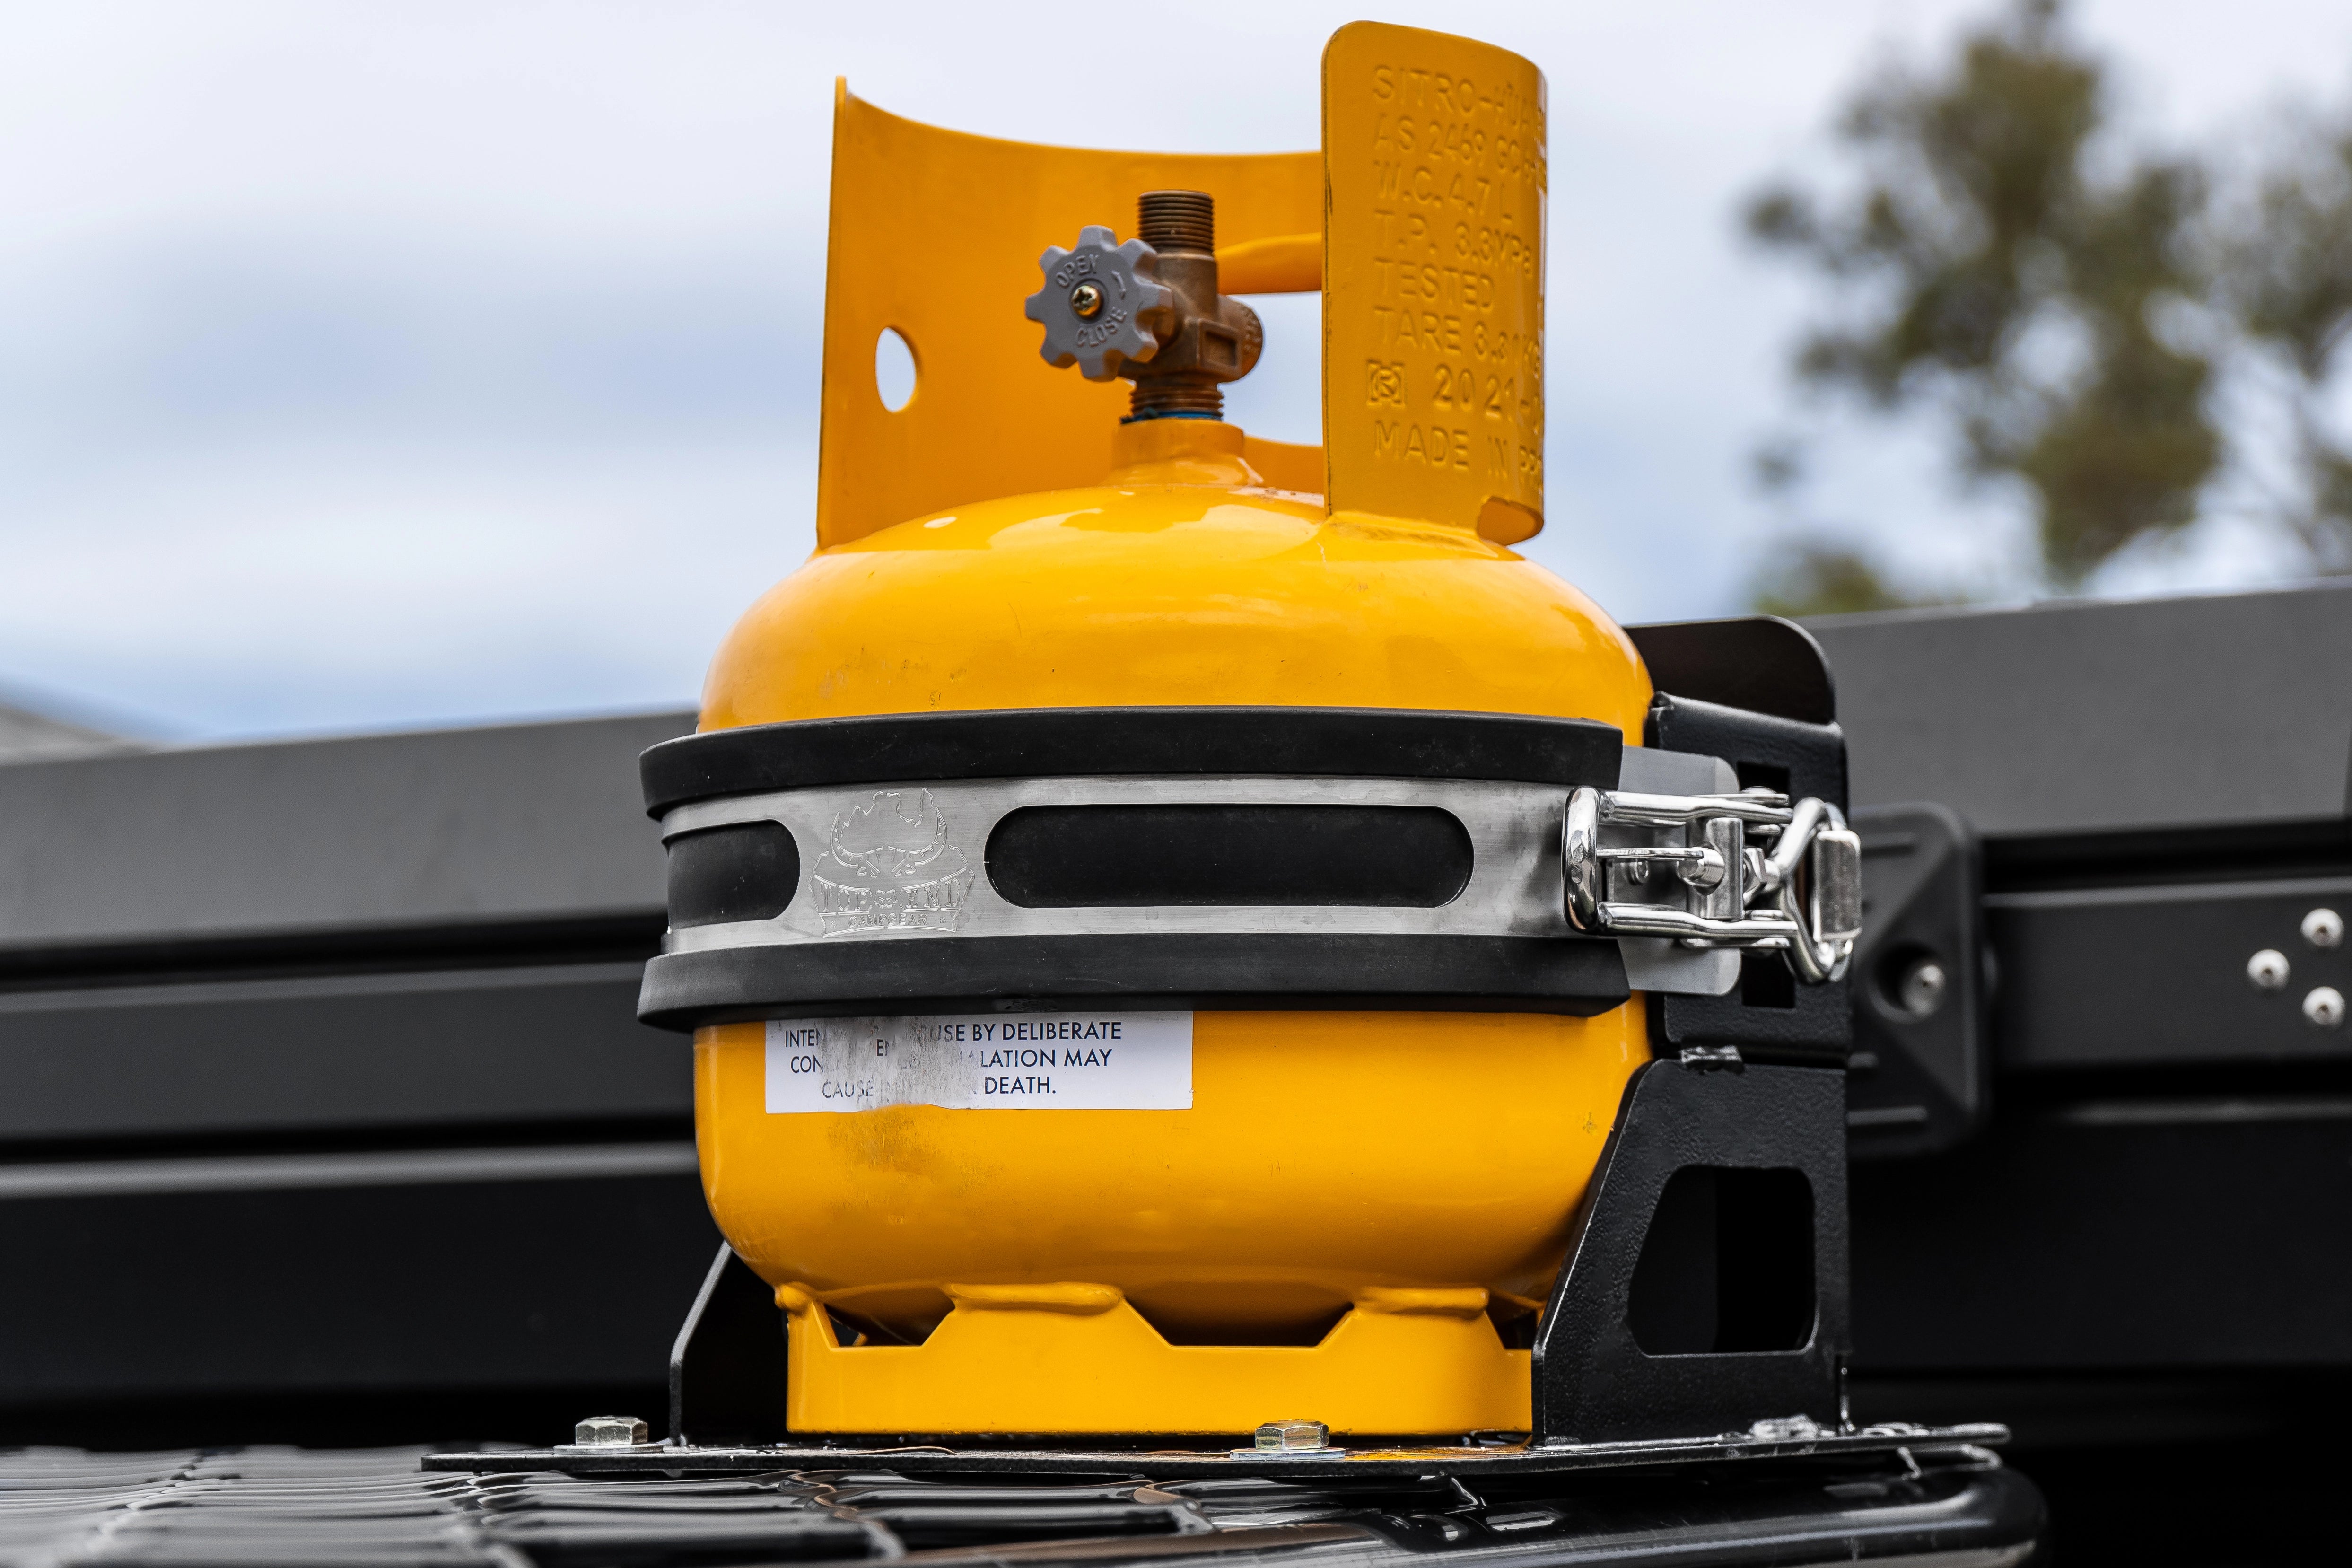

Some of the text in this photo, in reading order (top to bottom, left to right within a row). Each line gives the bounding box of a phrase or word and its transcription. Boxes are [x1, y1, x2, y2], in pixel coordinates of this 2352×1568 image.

[1374, 113, 1414, 151] AS
[1374, 208, 1437, 254] T.P.
[1055, 254, 1099, 288] OPEN
[1373, 256, 1494, 311] TESTED
[1076, 307, 1128, 347] CLOSE
[1374, 305, 1462, 353] TARE
[1373, 420, 1469, 471] MADE
[1487, 435, 1508, 478] IN
[819, 878, 962, 912] TOP END
[972, 1023, 996, 1041] BY
[1002, 1021, 1121, 1041] DELIBERATE
[959, 1049, 1056, 1067] LATION
[1064, 1048, 1113, 1067] MAY
[822, 1079, 874, 1098] CAUSE
[985, 1076, 1057, 1094] DEATH.
